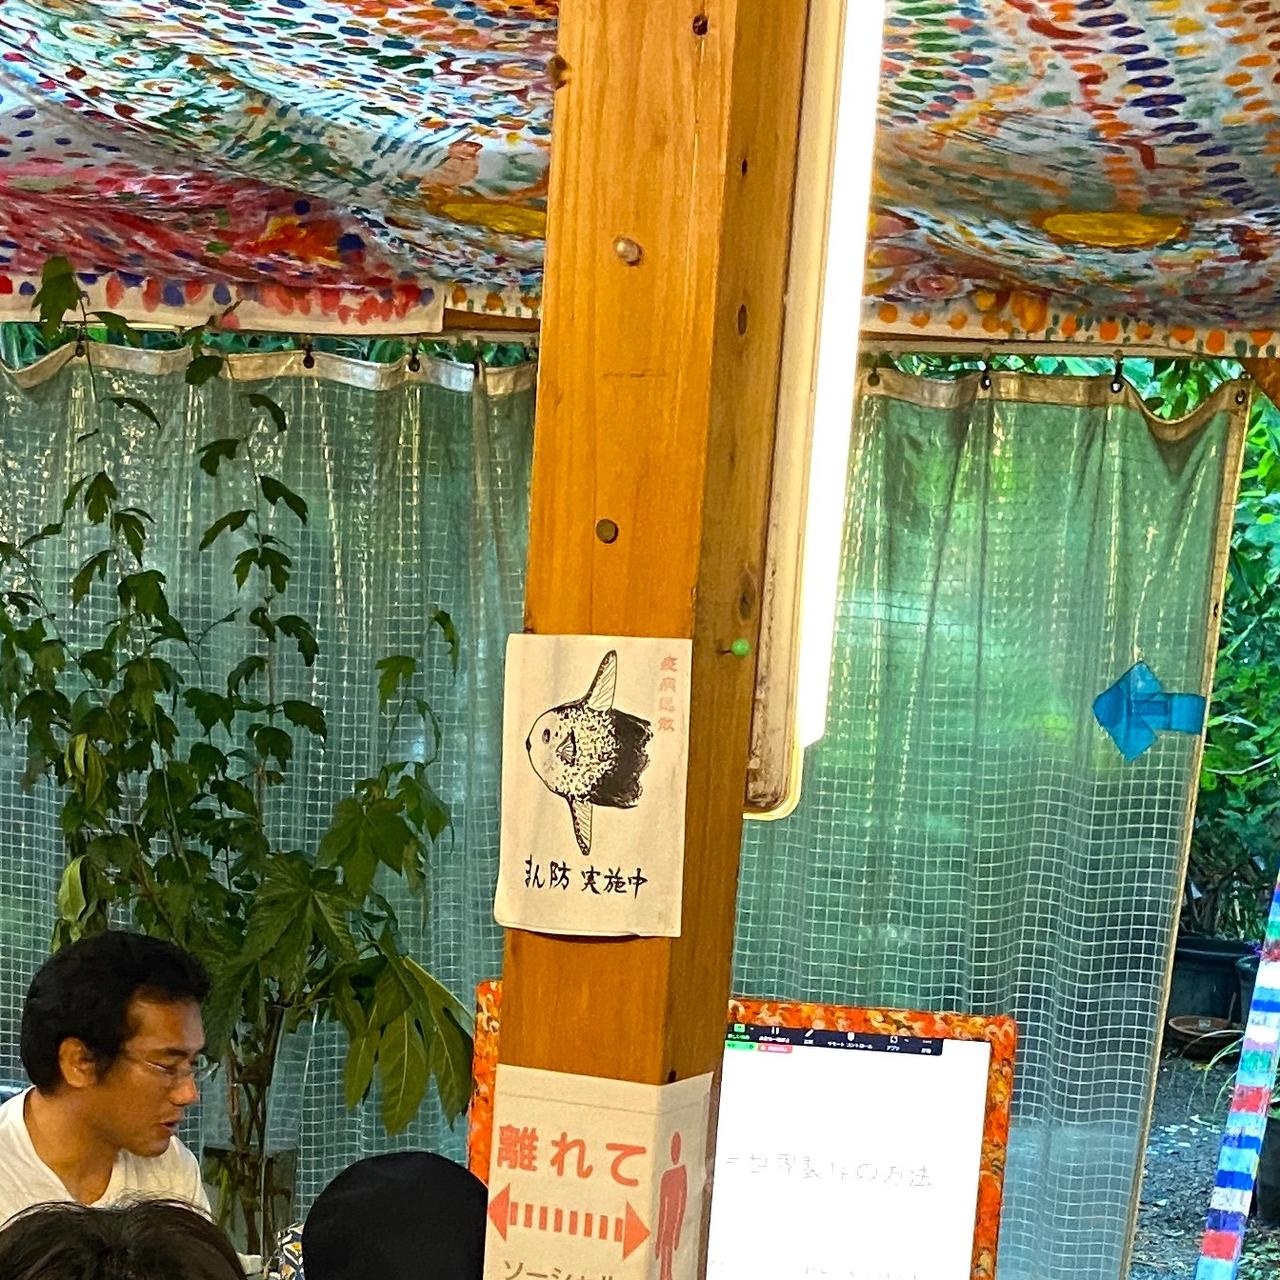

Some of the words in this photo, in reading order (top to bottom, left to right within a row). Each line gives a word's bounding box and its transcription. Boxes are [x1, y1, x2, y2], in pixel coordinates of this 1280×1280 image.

[581, 865, 648, 899] 実施中
[496, 1124, 647, 1187] 離れて
